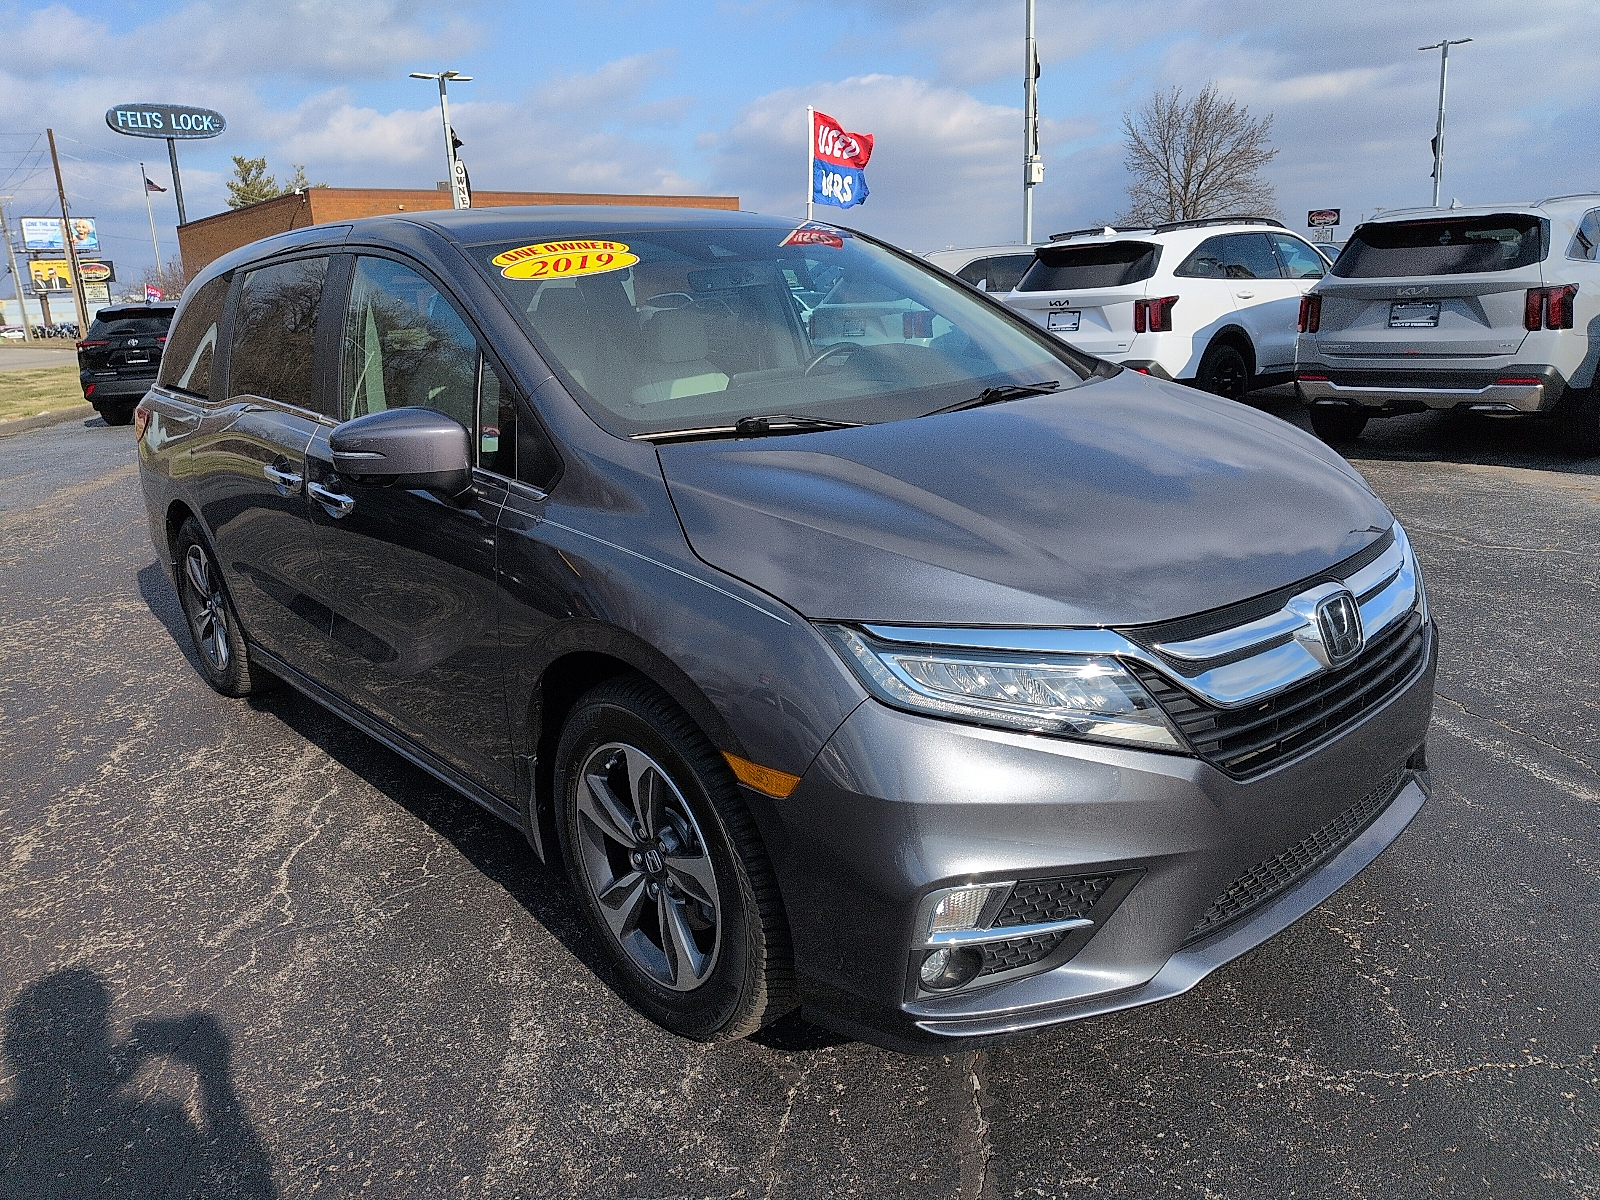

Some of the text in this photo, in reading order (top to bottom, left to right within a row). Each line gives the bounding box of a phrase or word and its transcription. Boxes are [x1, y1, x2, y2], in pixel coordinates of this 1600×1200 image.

[117, 111, 164, 129] FELTS
[170, 113, 215, 131] LOCK
[818, 124, 860, 159] USED
[455, 165, 469, 208] OWNE
[501, 241, 615, 262] ONE OWNER
[530, 253, 614, 277] 2019
